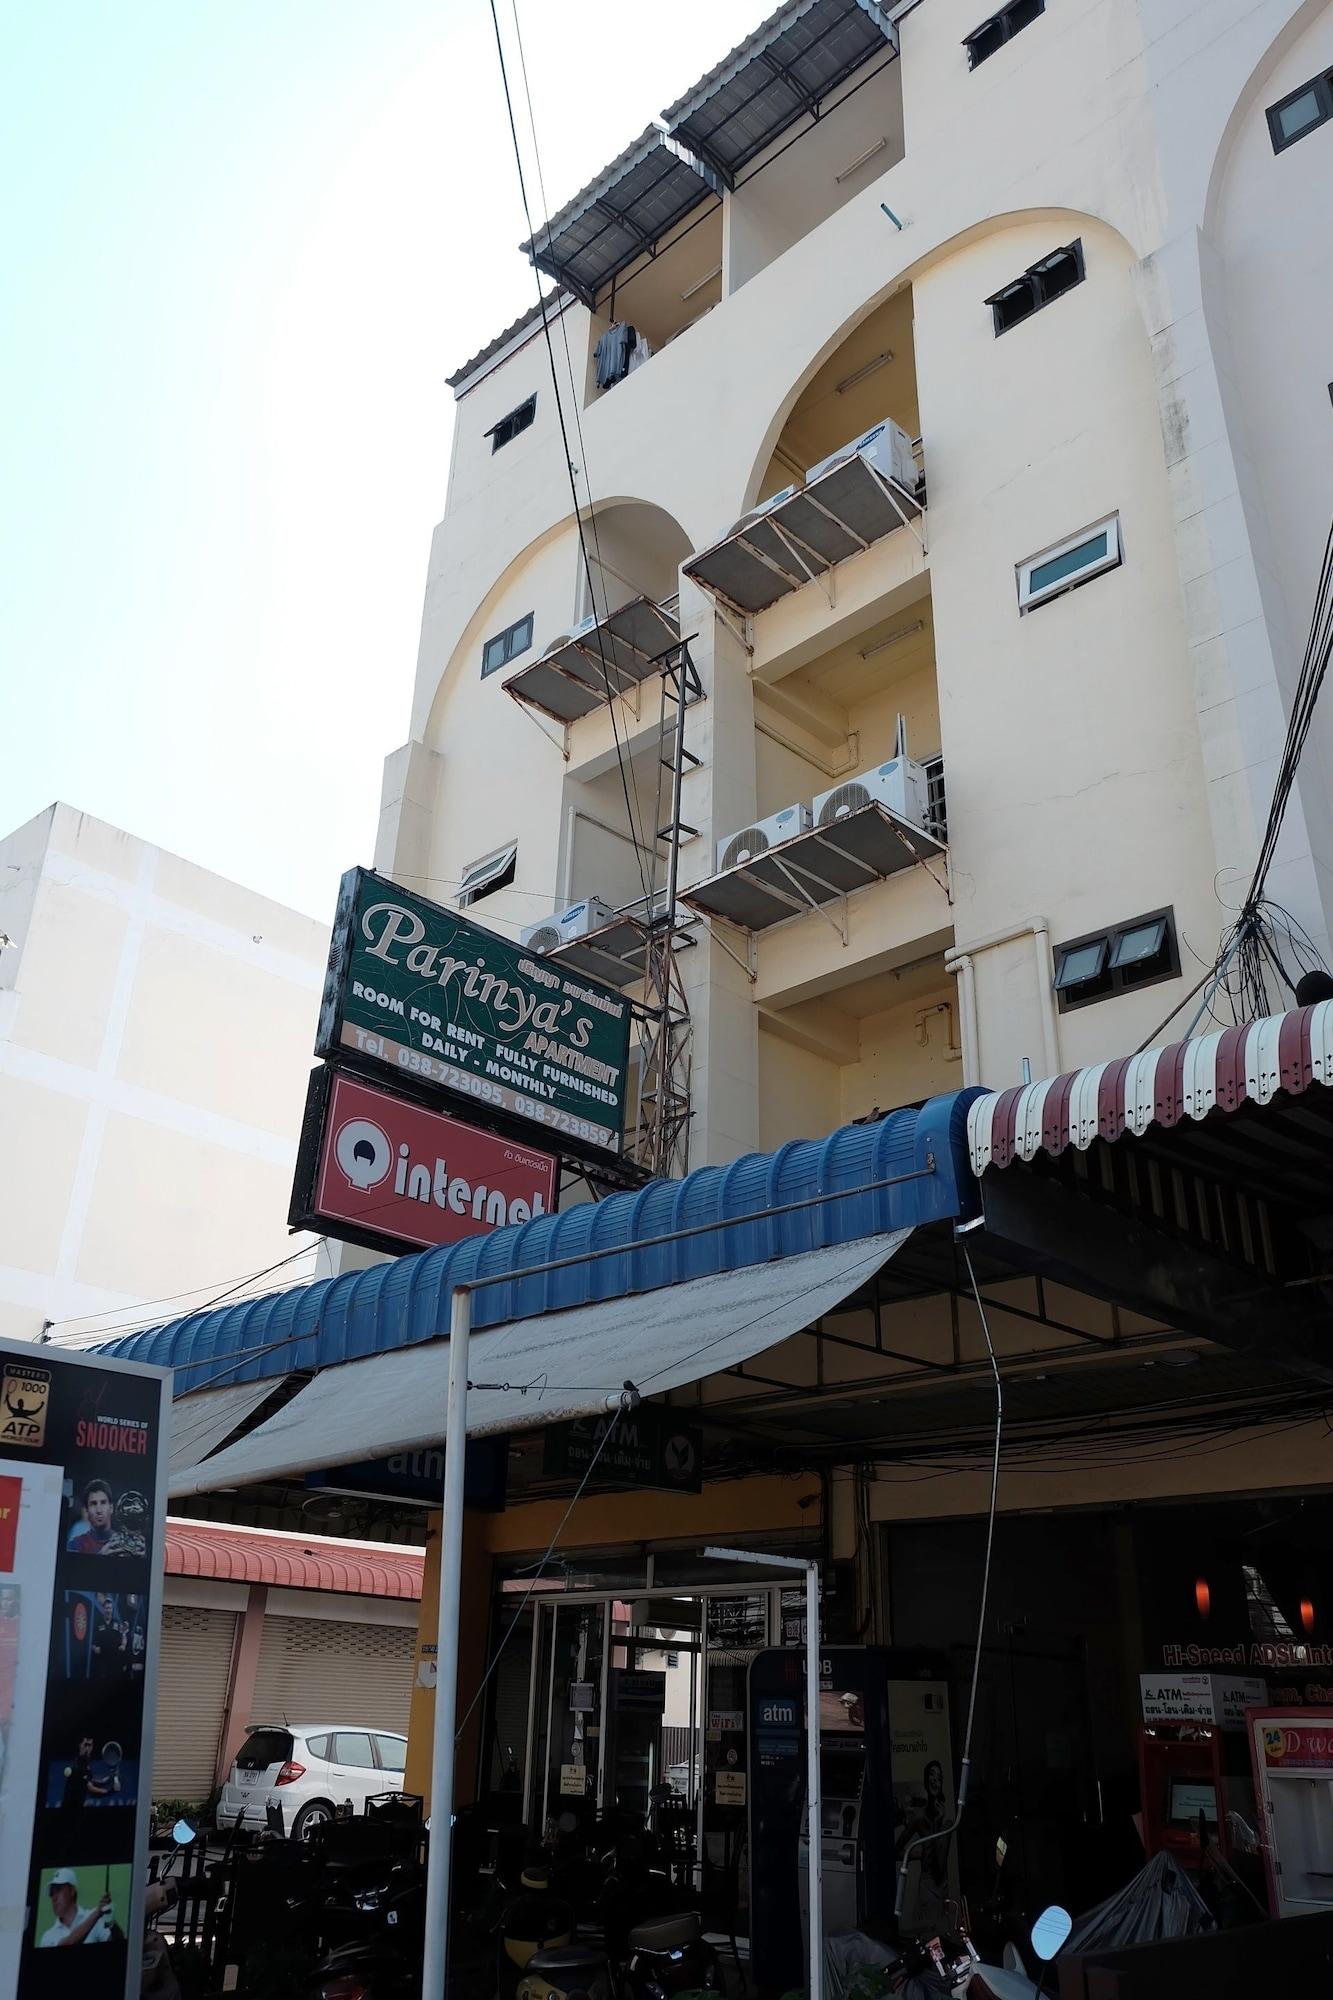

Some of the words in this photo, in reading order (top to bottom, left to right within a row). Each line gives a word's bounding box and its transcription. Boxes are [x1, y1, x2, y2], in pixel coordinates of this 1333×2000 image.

[361, 902, 594, 1048] Parinya's
[352, 980, 404, 1017] ROOM
[410, 1006, 442, 1032] FOR
[446, 1022, 486, 1050] RENT
[495, 1043, 539, 1071] FULLY
[542, 1063, 619, 1107] FURNISHED
[355, 1029, 389, 1059] Tel.
[397, 1048, 507, 1109] 038-723095,
[422, 1032, 473, 1064] DAILY
[485, 1059, 557, 1099] MONTHLY
[524, 1031, 620, 1087] APARTMENT
[21, 1382, 47, 1394] 1000
[2, 1421, 41, 1437] ATP
[97, 1415, 118, 1425] WORLD
[75, 1419, 148, 1456] SNOOKER
[1162, 1643, 1245, 1666] Hi-Speed
[1157, 1689, 1182, 1700] ATM
[763, 1704, 793, 1722] atm
[1266, 1730, 1281, 1744] 24
